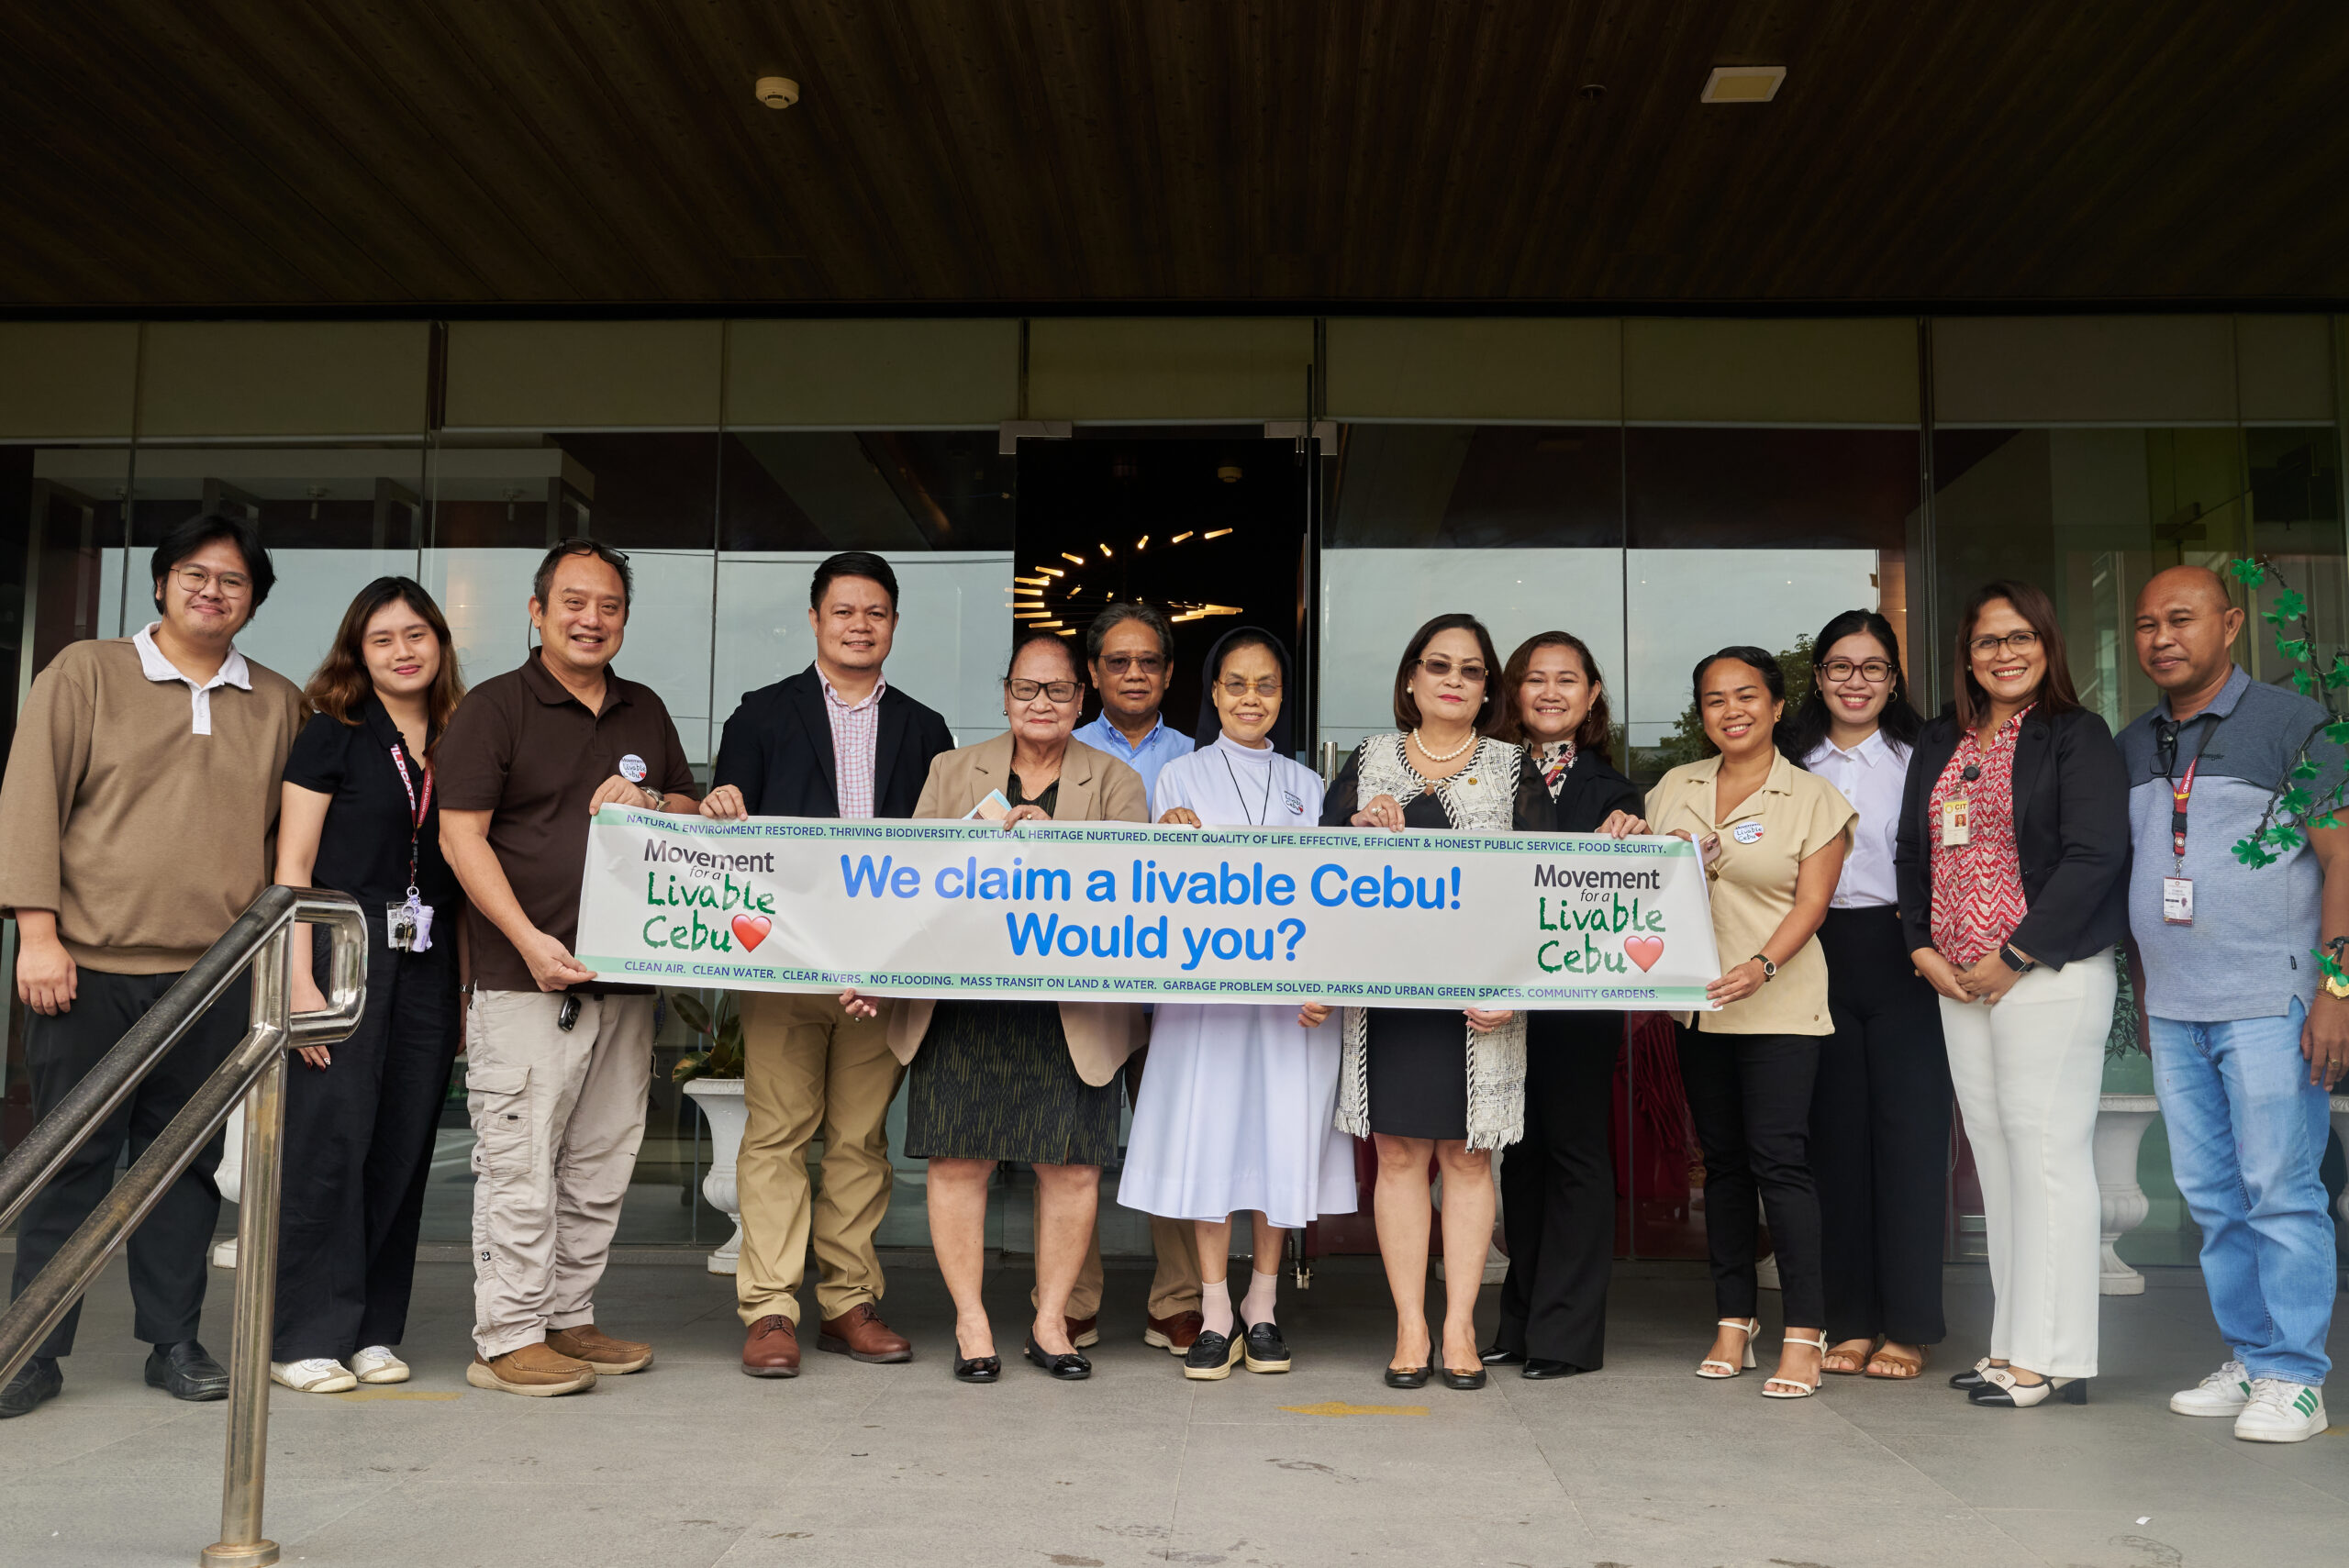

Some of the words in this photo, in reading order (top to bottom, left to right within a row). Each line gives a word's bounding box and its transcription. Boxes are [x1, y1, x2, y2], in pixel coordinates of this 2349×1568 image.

[390, 744, 416, 810] ILDCATS
[627, 814, 679, 831] NATURAL
[683, 824, 763, 836] ENVIRONMENT
[765, 826, 826, 837] RESTORED.
[830, 828, 883, 838] THRIVING
[885, 828, 965, 839] BIODIVERSITY.
[968, 829, 1026, 840] CULTURAL
[1029, 830, 1084, 840] HERITAGE
[1086, 831, 1151, 842] NURTURED.
[1153, 833, 1198, 842] DECENT
[1201, 833, 1249, 845] QUALITY
[1252, 834, 1268, 844] OF
[1271, 835, 1297, 845] LIFE.
[1299, 836, 1361, 847] EFFECTIVE,
[1364, 837, 1420, 848] EFFICIENT
[1423, 838, 1431, 848] &
[1435, 839, 1481, 849] HONEST
[1485, 840, 1524, 851] PUBLIC
[1527, 840, 1575, 851] SERVICE.
[1578, 842, 1610, 852] FOOD
[1614, 843, 1666, 854] SECURITY.
[1737, 827, 1762, 836] Livable
[1738, 833, 1756, 842] Cebu
[644, 839, 774, 873] Movement
[689, 865, 710, 879] for
[712, 872, 721, 881] a
[647, 872, 776, 914] Livable
[841, 854, 920, 898] We
[935, 856, 1071, 902] claim
[1085, 870, 1117, 903] a
[1132, 860, 1296, 906] livable
[1310, 863, 1461, 910] Cebu!
[1534, 864, 1660, 890] Movement
[1580, 889, 1599, 903] for
[1601, 893, 1610, 903] a
[643, 909, 732, 953] Cebu
[1539, 892, 1666, 934] Livable
[1006, 912, 1168, 959] Would
[1181, 918, 1307, 971] you?
[1537, 933, 1628, 975] Cebu
[625, 961, 662, 973] CLEAN
[665, 963, 686, 973] AIR.
[693, 965, 730, 976] CLEAN
[733, 967, 776, 979] WATER.
[783, 970, 819, 982] CLEAR
[821, 972, 863, 984] RIVERS.
[870, 974, 888, 984] NO
[891, 975, 954, 985] FLOODING.
[961, 977, 993, 987] MASS
[995, 977, 1044, 987] TRANSIT
[1047, 978, 1064, 988] ON
[1067, 978, 1098, 989] LAND
[1102, 979, 1110, 989] &
[1114, 980, 1157, 990] WATER.
[1163, 981, 1217, 991] GARBAGE
[1219, 982, 1273, 992] PROBLEM
[1276, 983, 1323, 993] SOLVED.
[1327, 984, 1364, 995] PARKS
[1366, 984, 1391, 995] AND
[1395, 985, 1434, 996] URBAN
[1437, 986, 1475, 997] GREEN
[1478, 987, 1524, 998] SPACES.
[1528, 988, 1598, 998] COMMUNITY
[1601, 988, 1658, 999] GARDENS.
